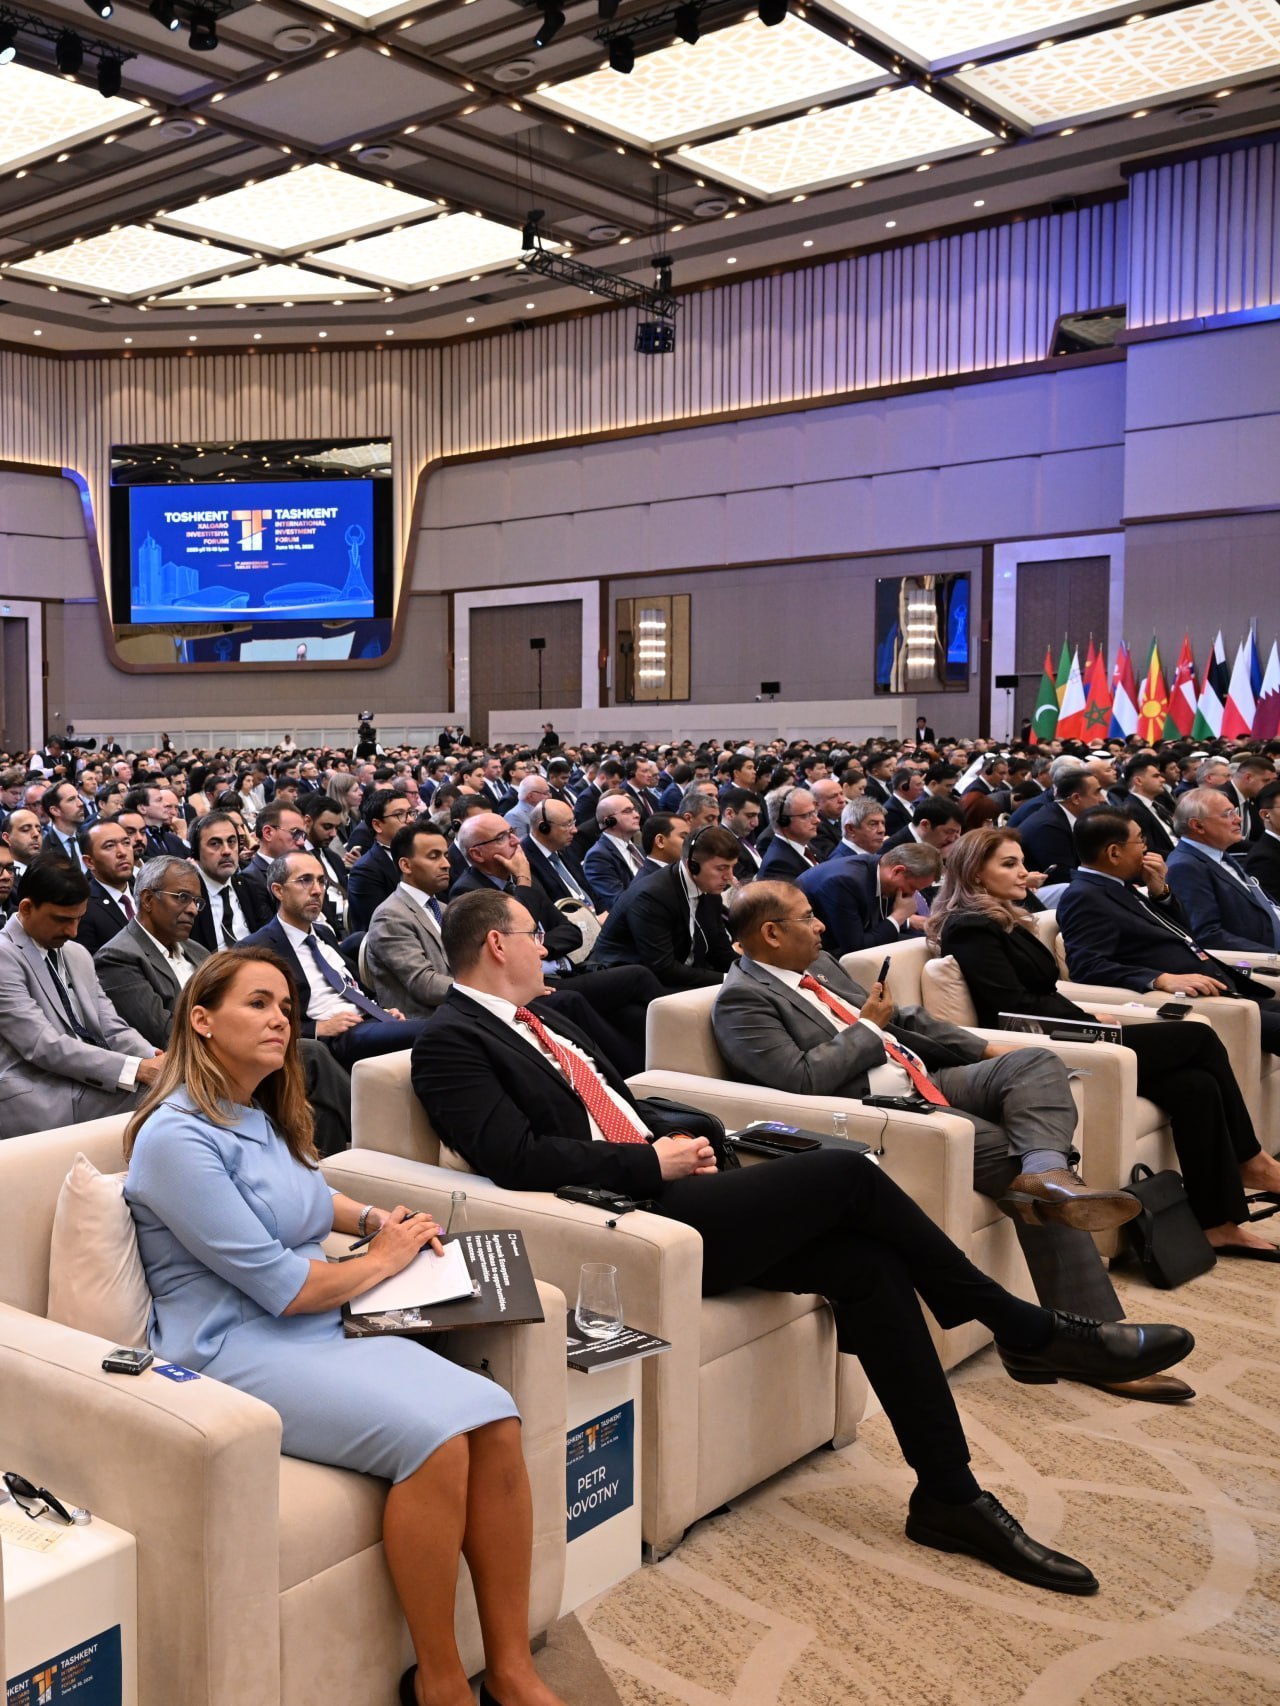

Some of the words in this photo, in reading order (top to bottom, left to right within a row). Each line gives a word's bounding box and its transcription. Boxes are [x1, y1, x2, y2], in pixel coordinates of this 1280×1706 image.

[164, 510, 229, 523] TOSHKENT
[275, 507, 339, 520] TASHKENT
[577, 1465, 606, 1494] PETR
[566, 1480, 620, 1521] NOVOTNY
[60, 1643, 98, 1669] TASHKENT
